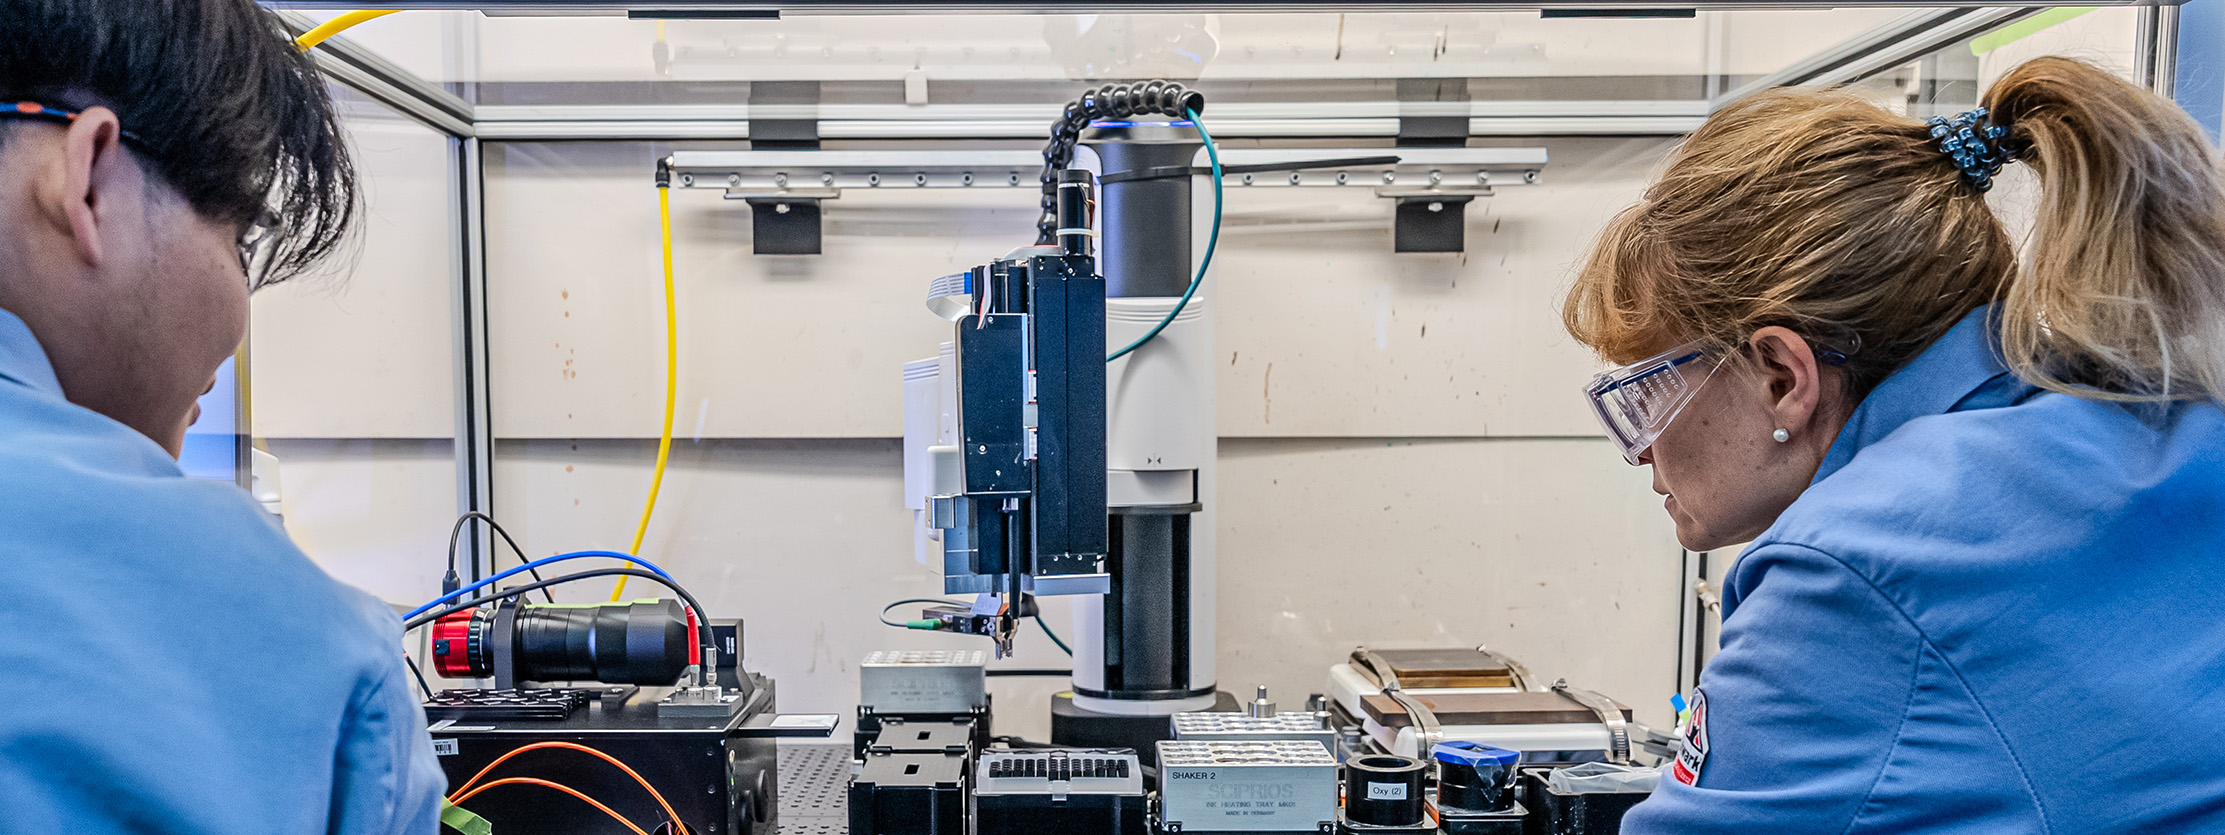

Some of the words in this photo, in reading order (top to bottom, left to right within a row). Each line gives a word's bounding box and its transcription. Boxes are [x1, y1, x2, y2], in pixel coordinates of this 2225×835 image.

[1172, 771, 1208, 780] SHAKER
[1210, 771, 1216, 780] 2
[1373, 786, 1389, 796] Oxy
[1391, 787, 1402, 796] (2)
